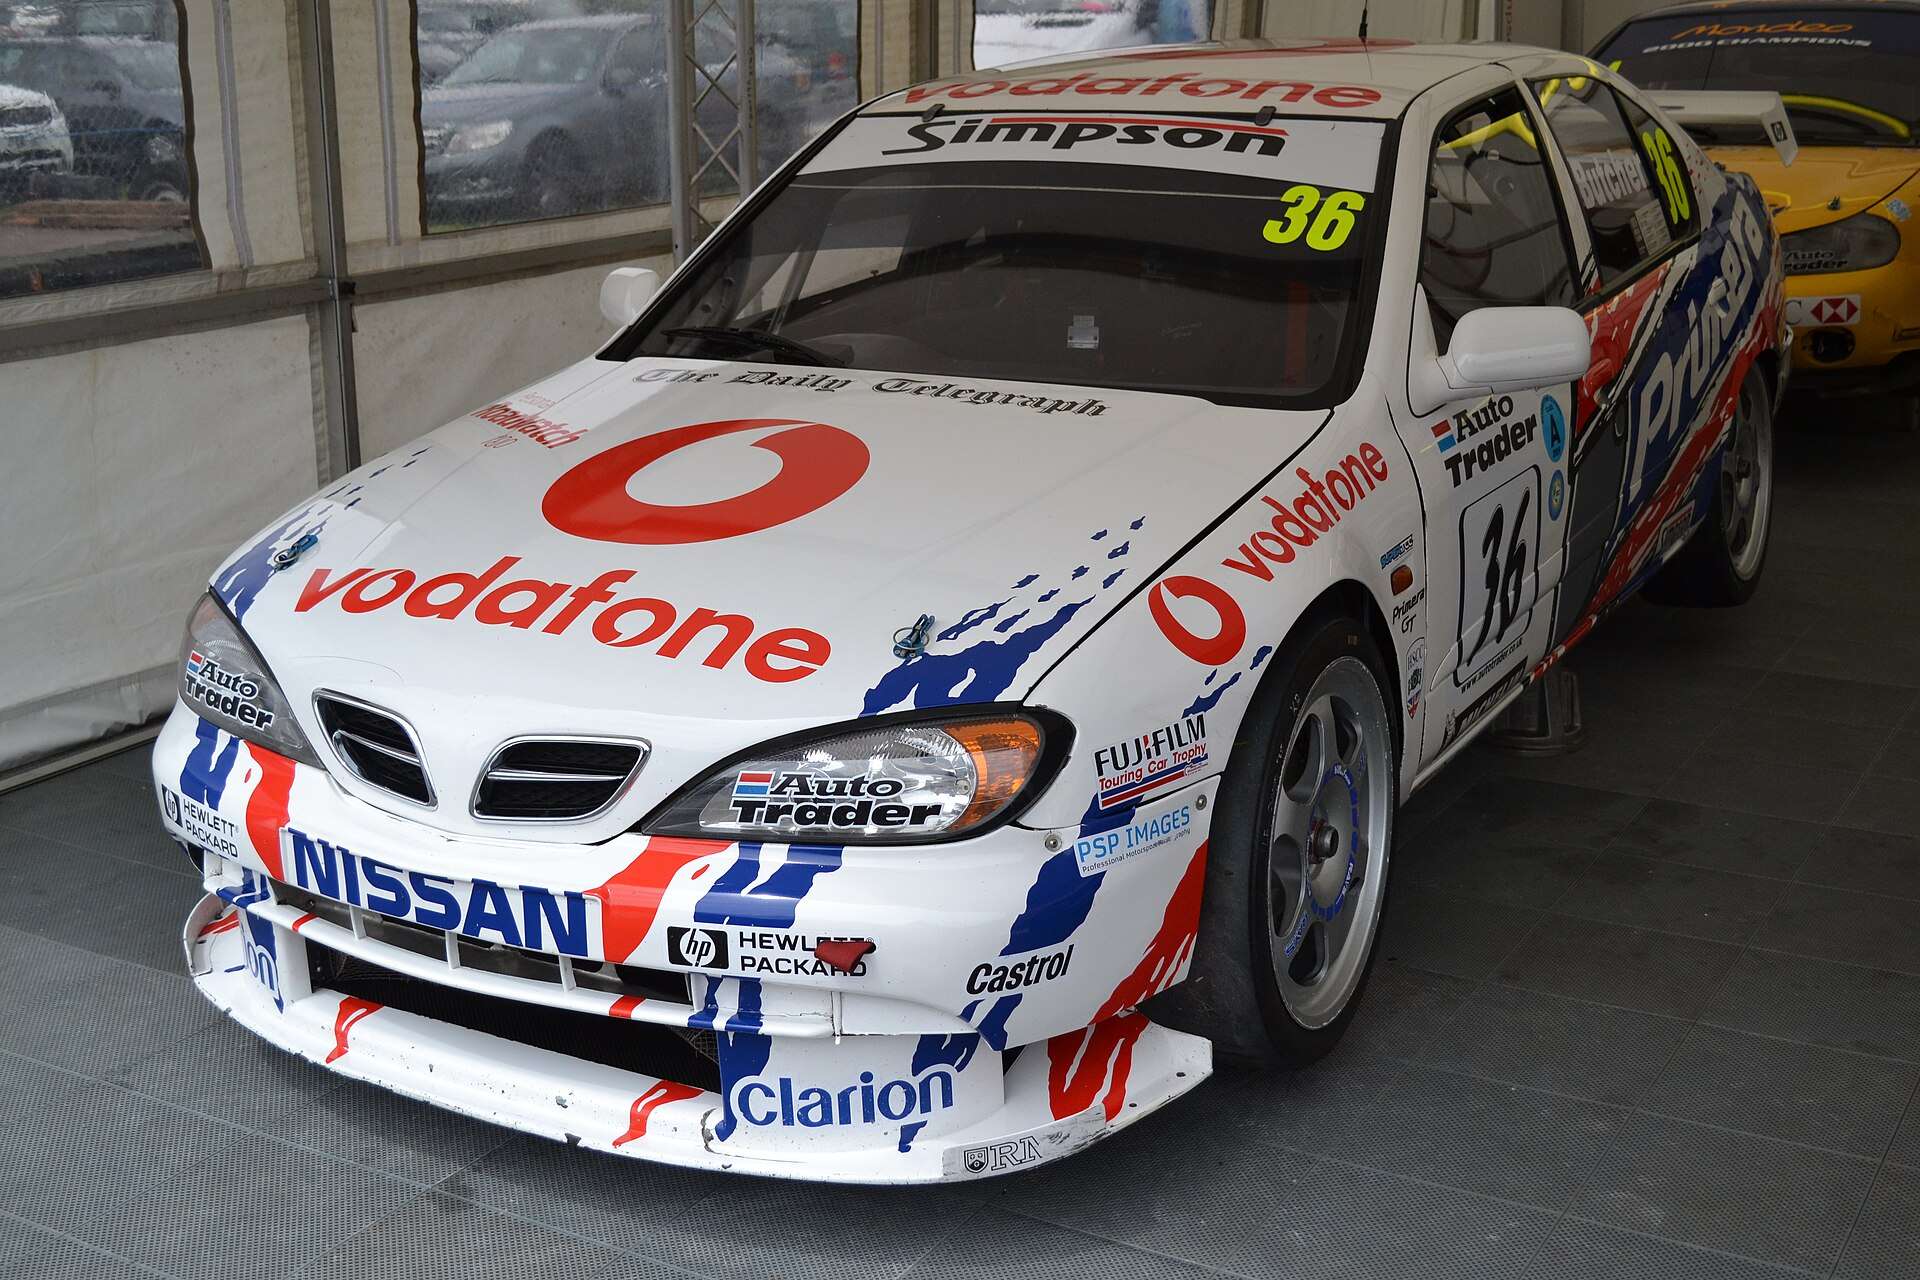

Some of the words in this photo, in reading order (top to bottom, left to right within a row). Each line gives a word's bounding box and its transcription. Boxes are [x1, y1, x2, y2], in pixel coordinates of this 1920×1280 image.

[1670, 20, 1854, 39] Mondeo
[1716, 36, 1872, 48] CHAMPIONS
[904, 72, 1383, 108] vodafone
[881, 119, 1287, 157] Simpson
[1642, 127, 1690, 224] 36
[1261, 185, 1366, 251] 36
[1783, 259, 1848, 270] rader
[632, 366, 720, 384] The
[723, 370, 854, 392] Daily
[872, 377, 1112, 417] Telegraph
[1452, 395, 1514, 443] Auto
[1444, 413, 1537, 488] Trader
[1220, 442, 1388, 582] vodafone
[1466, 487, 1531, 667] 36
[293, 555, 832, 684] vodafone
[1392, 587, 1425, 625] Primera
[1401, 613, 1417, 634] GT
[198, 660, 258, 698] Auto
[1461, 637, 1523, 695] www.autotrader.co.uk
[185, 673, 274, 729] Trader
[1094, 713, 1207, 777] FUJIFILM
[1098, 767, 1143, 791] Touring
[1147, 758, 1168, 773] Car
[1172, 742, 1207, 764] Trophy
[769, 773, 903, 797] Auto
[731, 800, 943, 826] Trader
[1077, 832, 1119, 863] PSP
[1125, 805, 1190, 848] IMAGES
[185, 821, 238, 858] PACKARD
[1082, 853, 1125, 873] Professional
[287, 826, 589, 957] NISSAN
[684, 928, 712, 968] hp
[965, 943, 1075, 996] Castrol
[737, 1070, 954, 1128] Clarion
